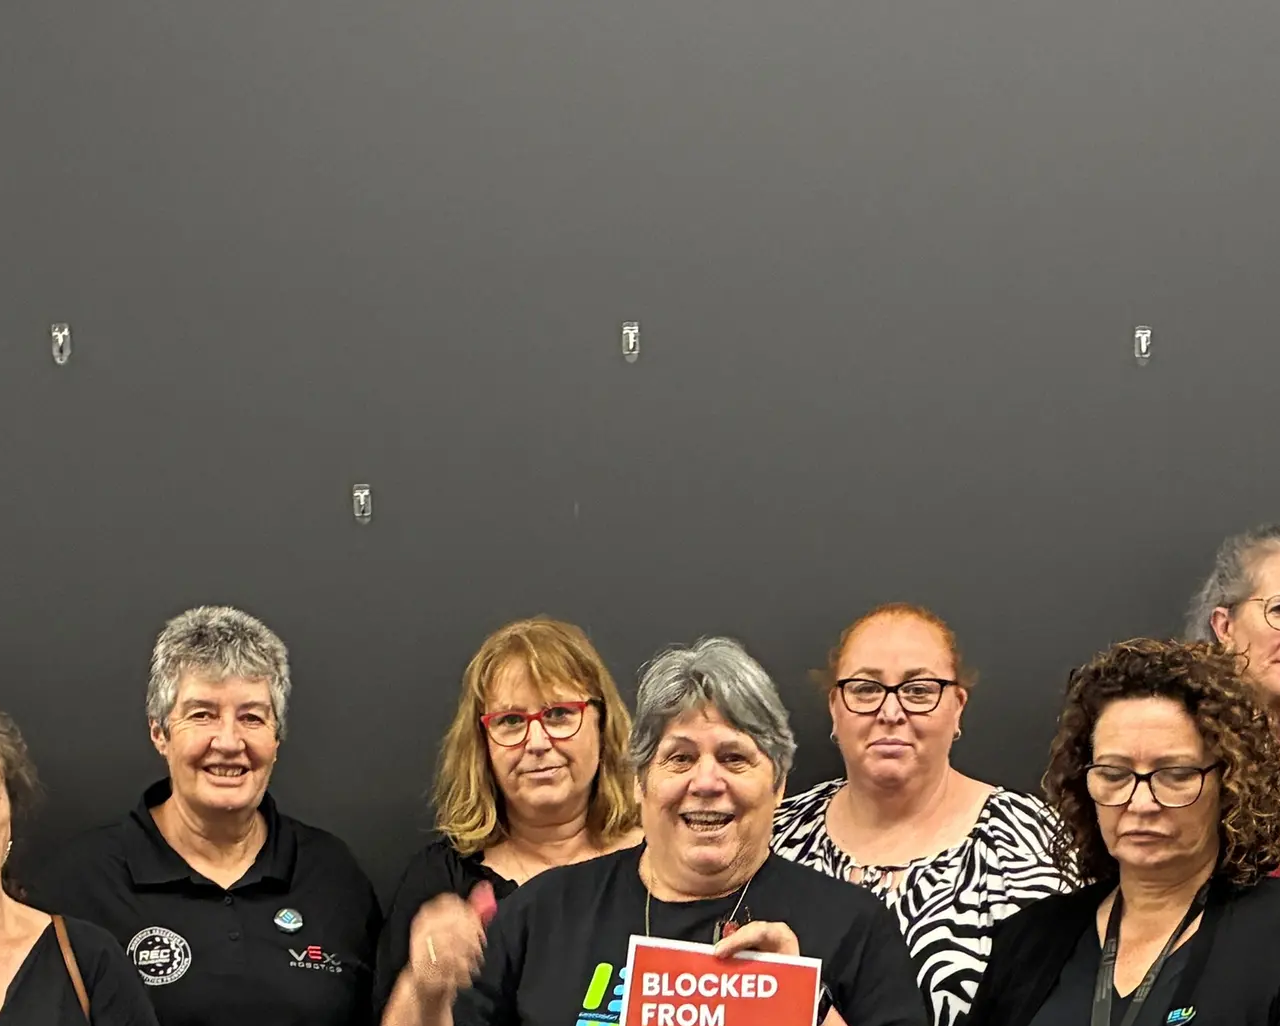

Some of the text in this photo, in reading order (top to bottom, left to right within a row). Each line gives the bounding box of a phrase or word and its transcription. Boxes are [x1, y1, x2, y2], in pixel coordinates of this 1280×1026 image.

[288, 945, 341, 965] VEX
[289, 961, 343, 973] ROBOTICS
[642, 972, 778, 998] BLOCKED
